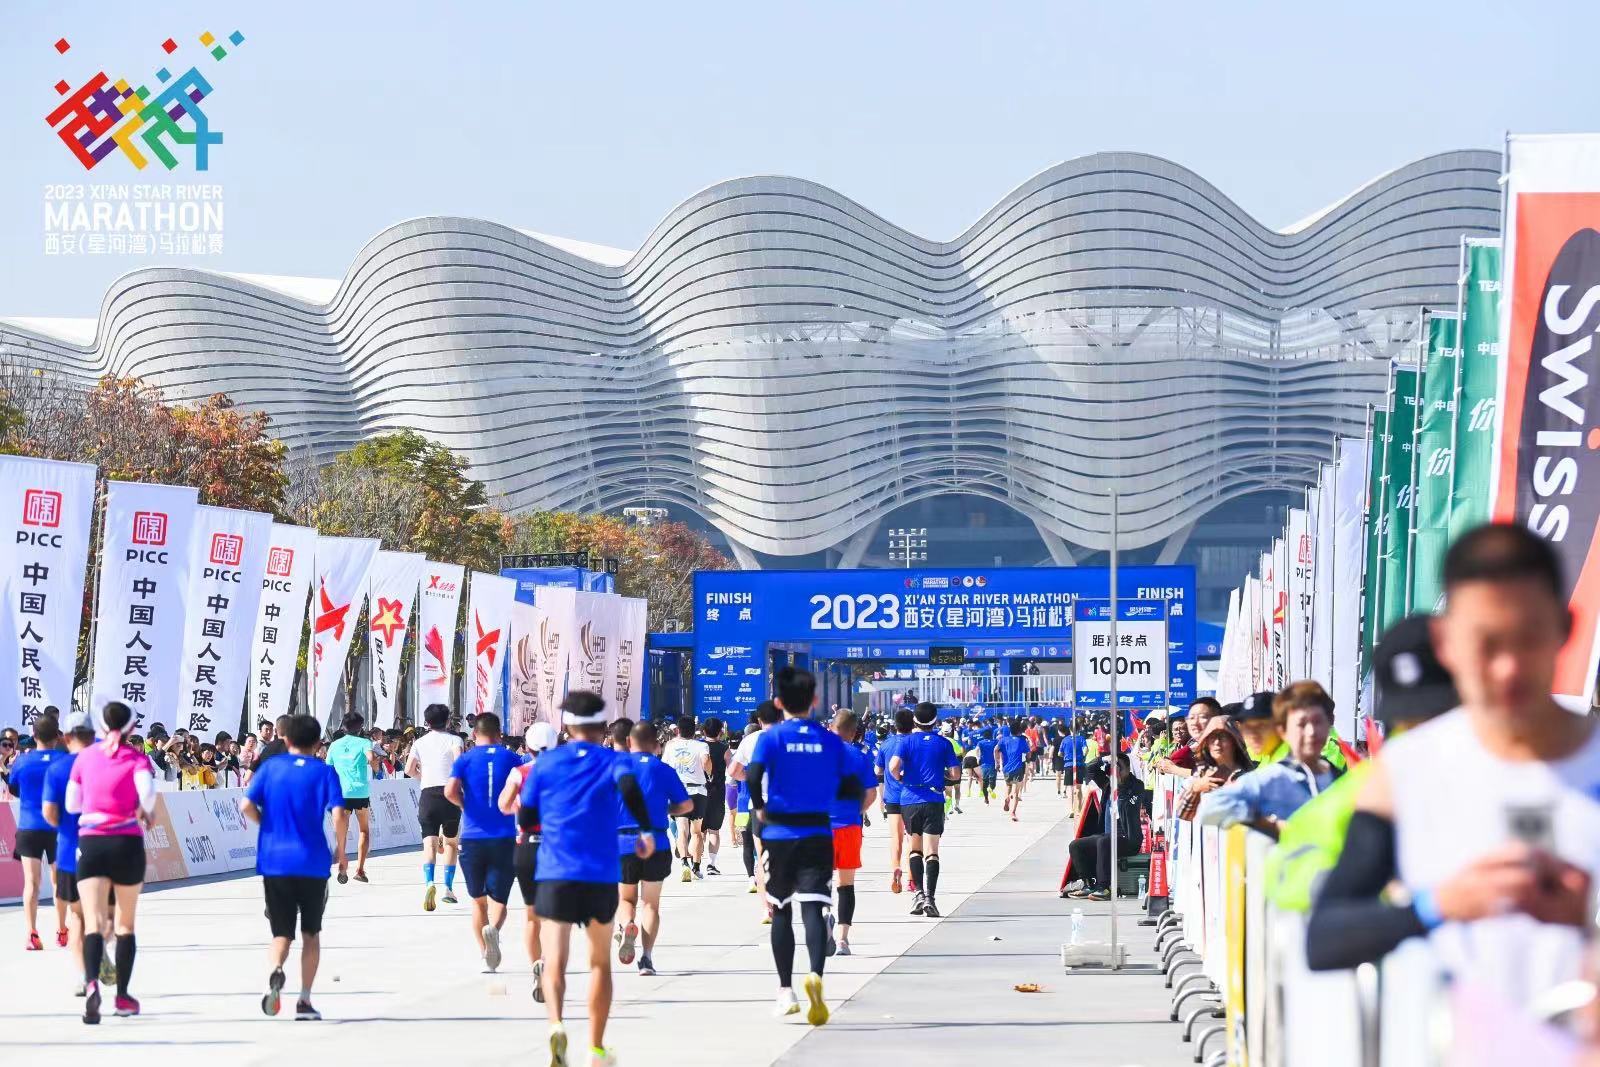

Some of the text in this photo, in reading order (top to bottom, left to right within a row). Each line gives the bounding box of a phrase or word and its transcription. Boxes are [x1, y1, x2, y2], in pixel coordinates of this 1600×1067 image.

[1478, 280, 1501, 291] TEA
[16, 531, 63, 548] PICC
[126, 549, 169, 564] PICC
[203, 568, 242, 583] PICC
[262, 579, 292, 592] PICC
[1137, 587, 1184, 599] FINISH
[706, 592, 752, 604] FINISH
[904, 592, 1079, 605] XI'AN STAR RIVER MARATHON
[809, 593, 900, 630] 2023
[1170, 603, 1184, 616] 点
[20, 562, 49, 726] 中国人民保险
[189, 594, 229, 732] 中国人民保险
[1089, 656, 1151, 675] 100m
